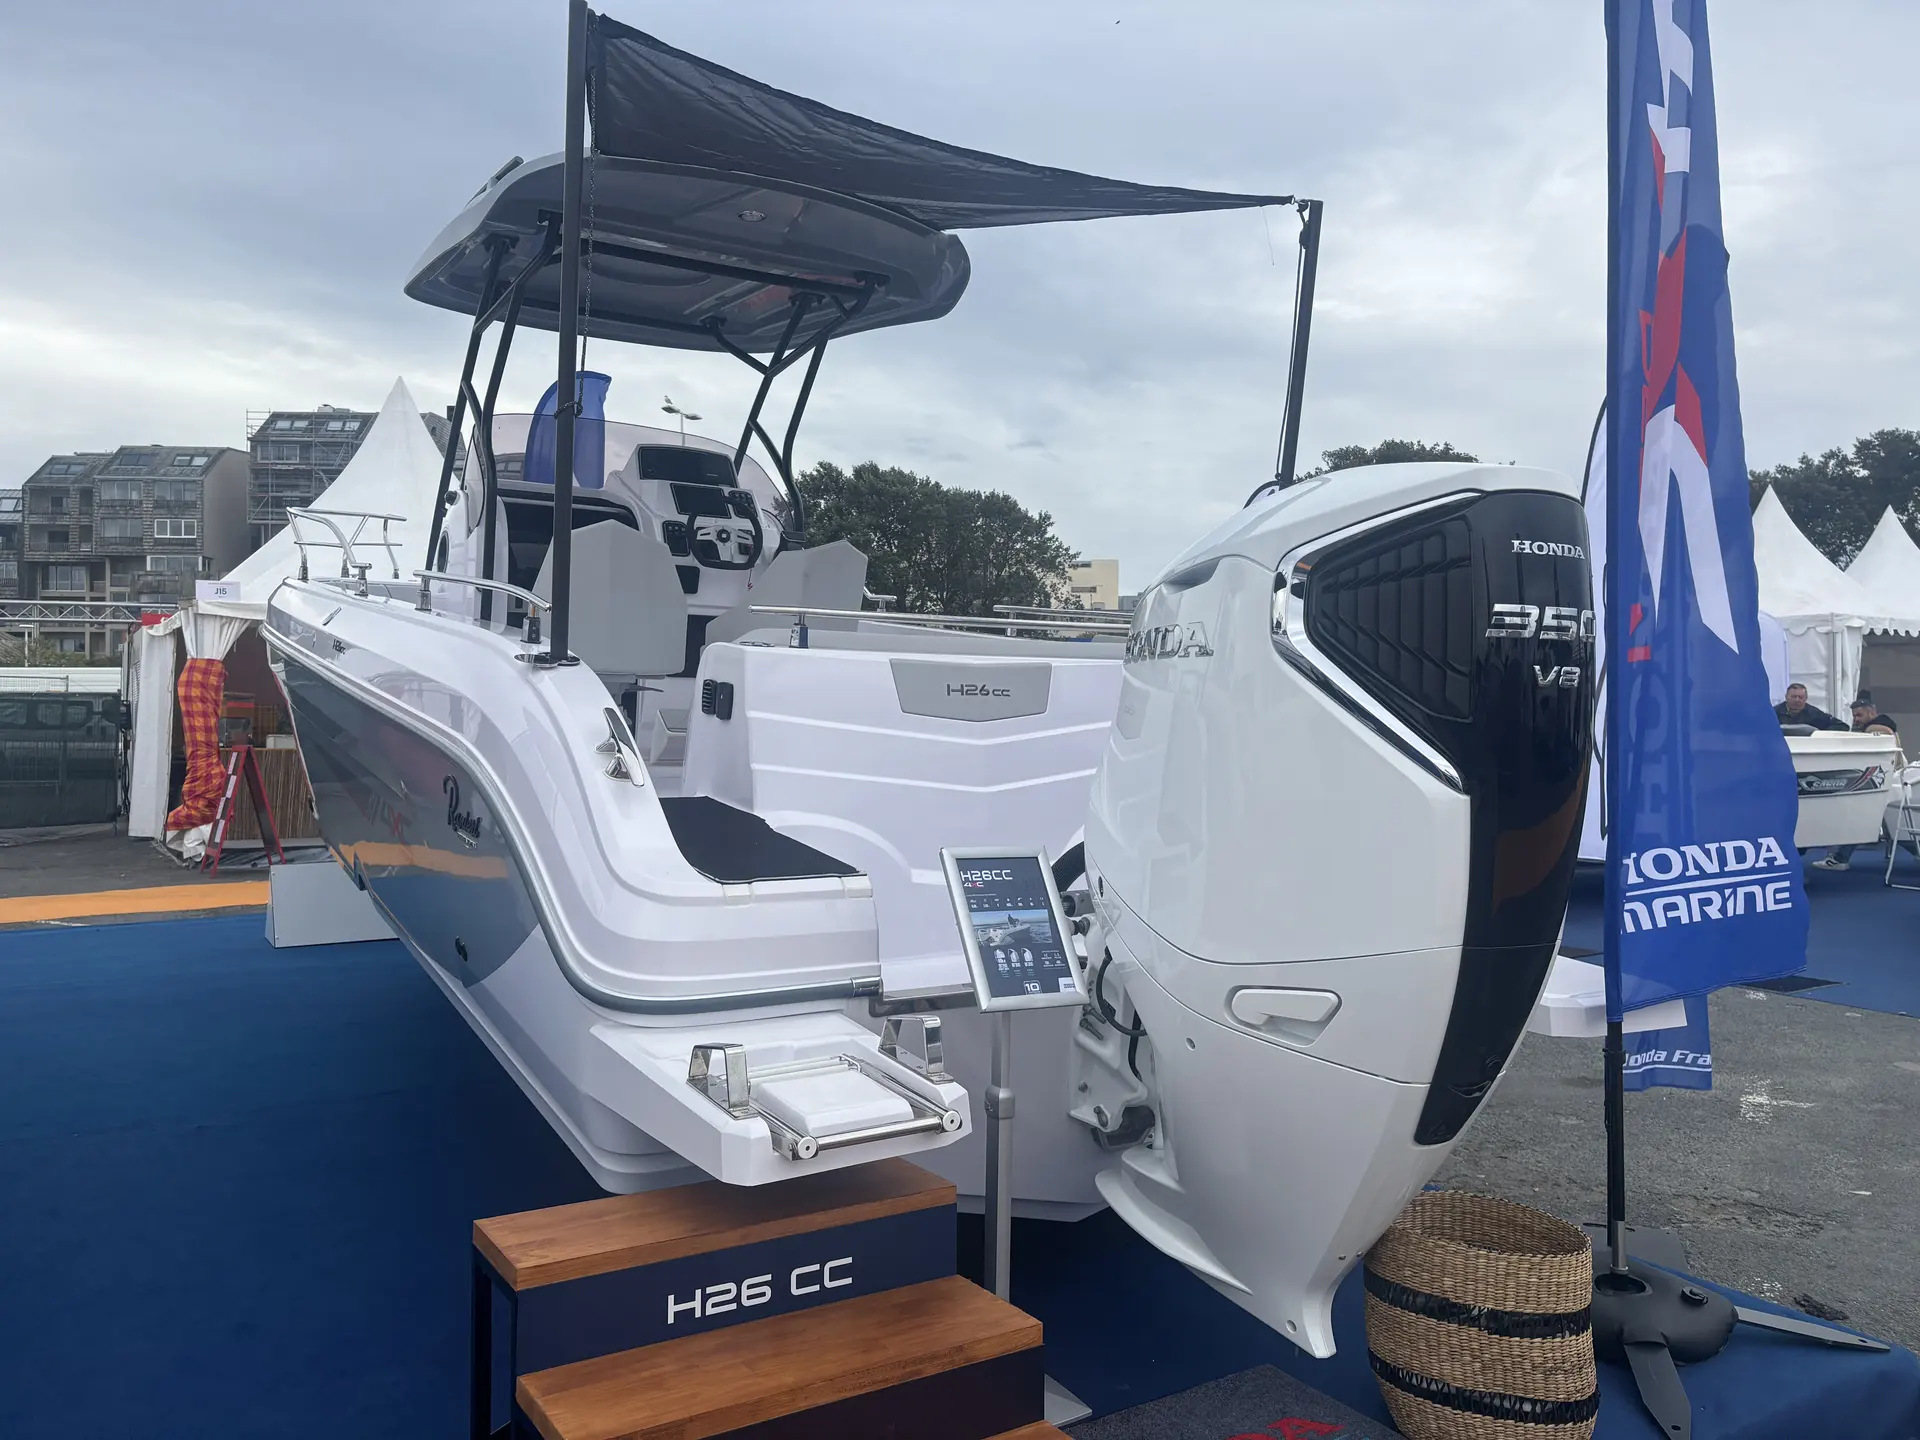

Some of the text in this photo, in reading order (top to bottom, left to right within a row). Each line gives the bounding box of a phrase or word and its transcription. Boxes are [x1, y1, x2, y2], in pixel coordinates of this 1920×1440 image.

[1511, 539, 1586, 560] HONDA
[214, 587, 228, 596] J15
[1485, 603, 1596, 643] 350
[1533, 664, 1582, 689] V8
[946, 683, 990, 697] H26
[960, 869, 1014, 881] H26CC
[667, 1256, 853, 1325] H26 CC
